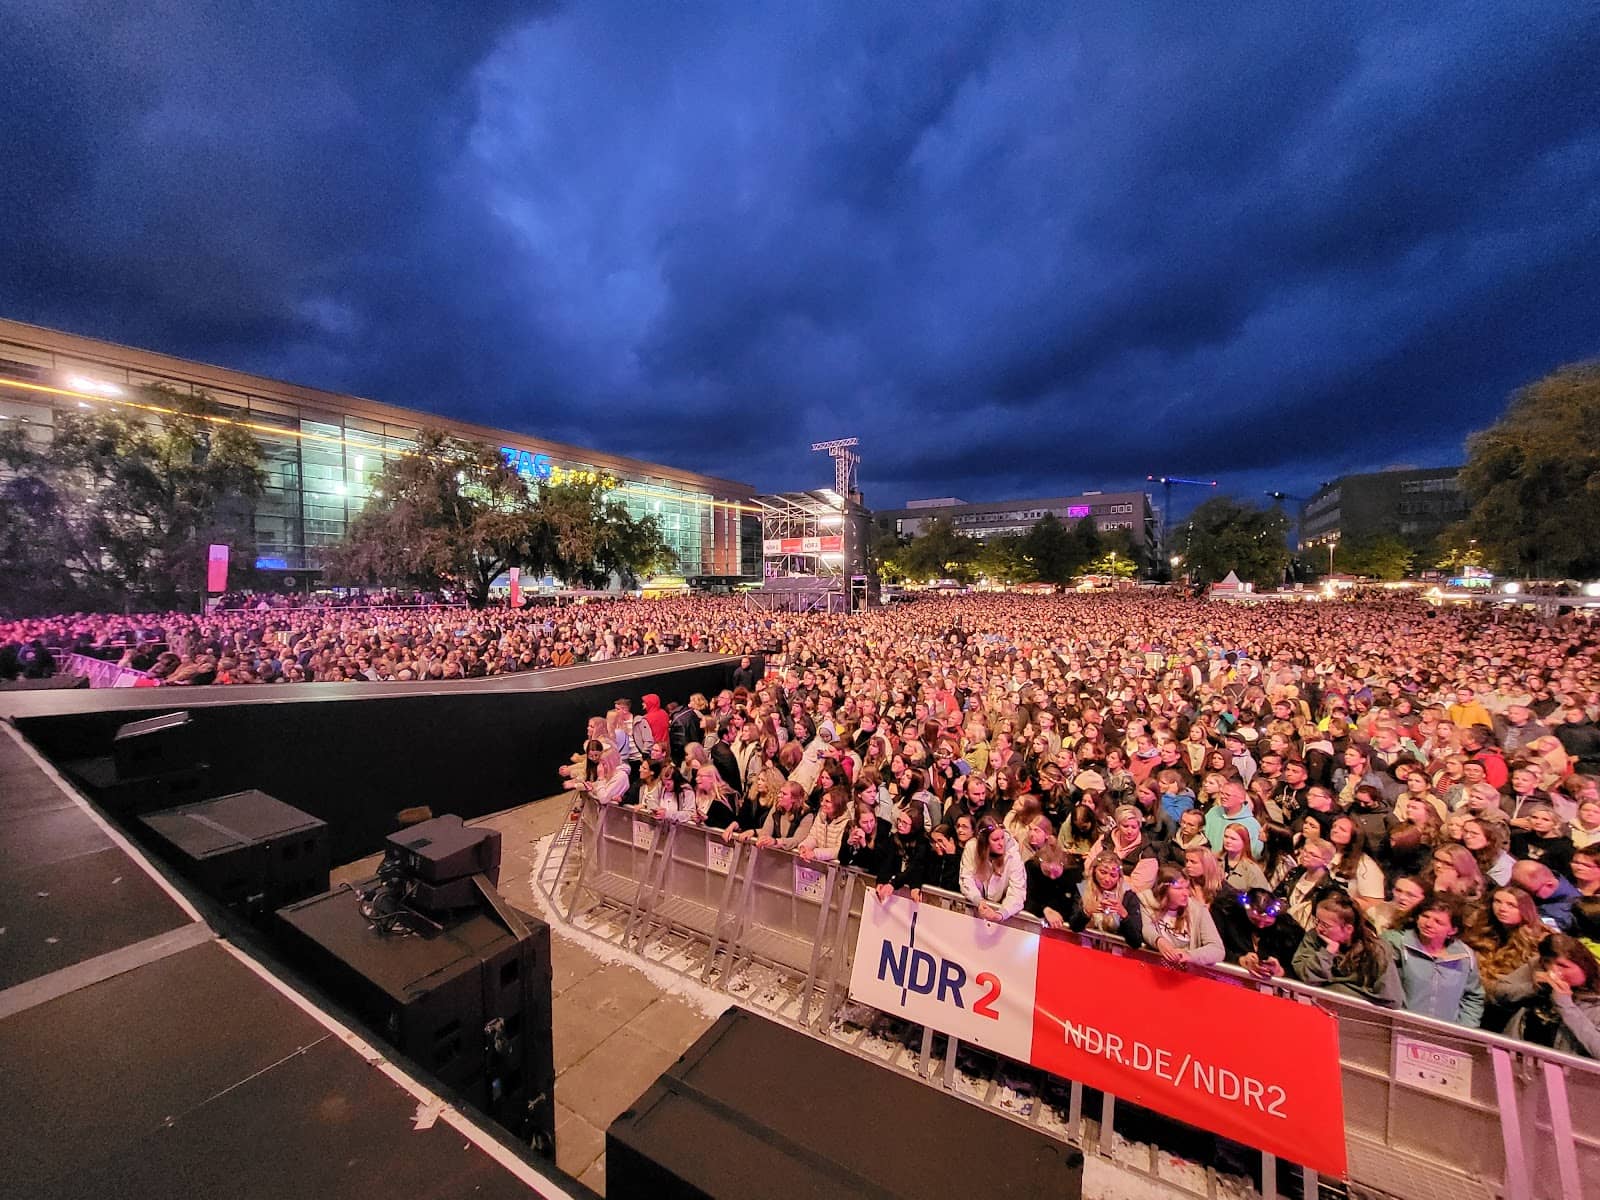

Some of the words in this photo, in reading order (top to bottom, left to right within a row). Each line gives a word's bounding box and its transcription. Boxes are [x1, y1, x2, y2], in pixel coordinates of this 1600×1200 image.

[877, 939, 967, 1009] NDR
[972, 971, 1002, 1021] 2
[1064, 1020, 1288, 1119] NDR.DE/NDR2
